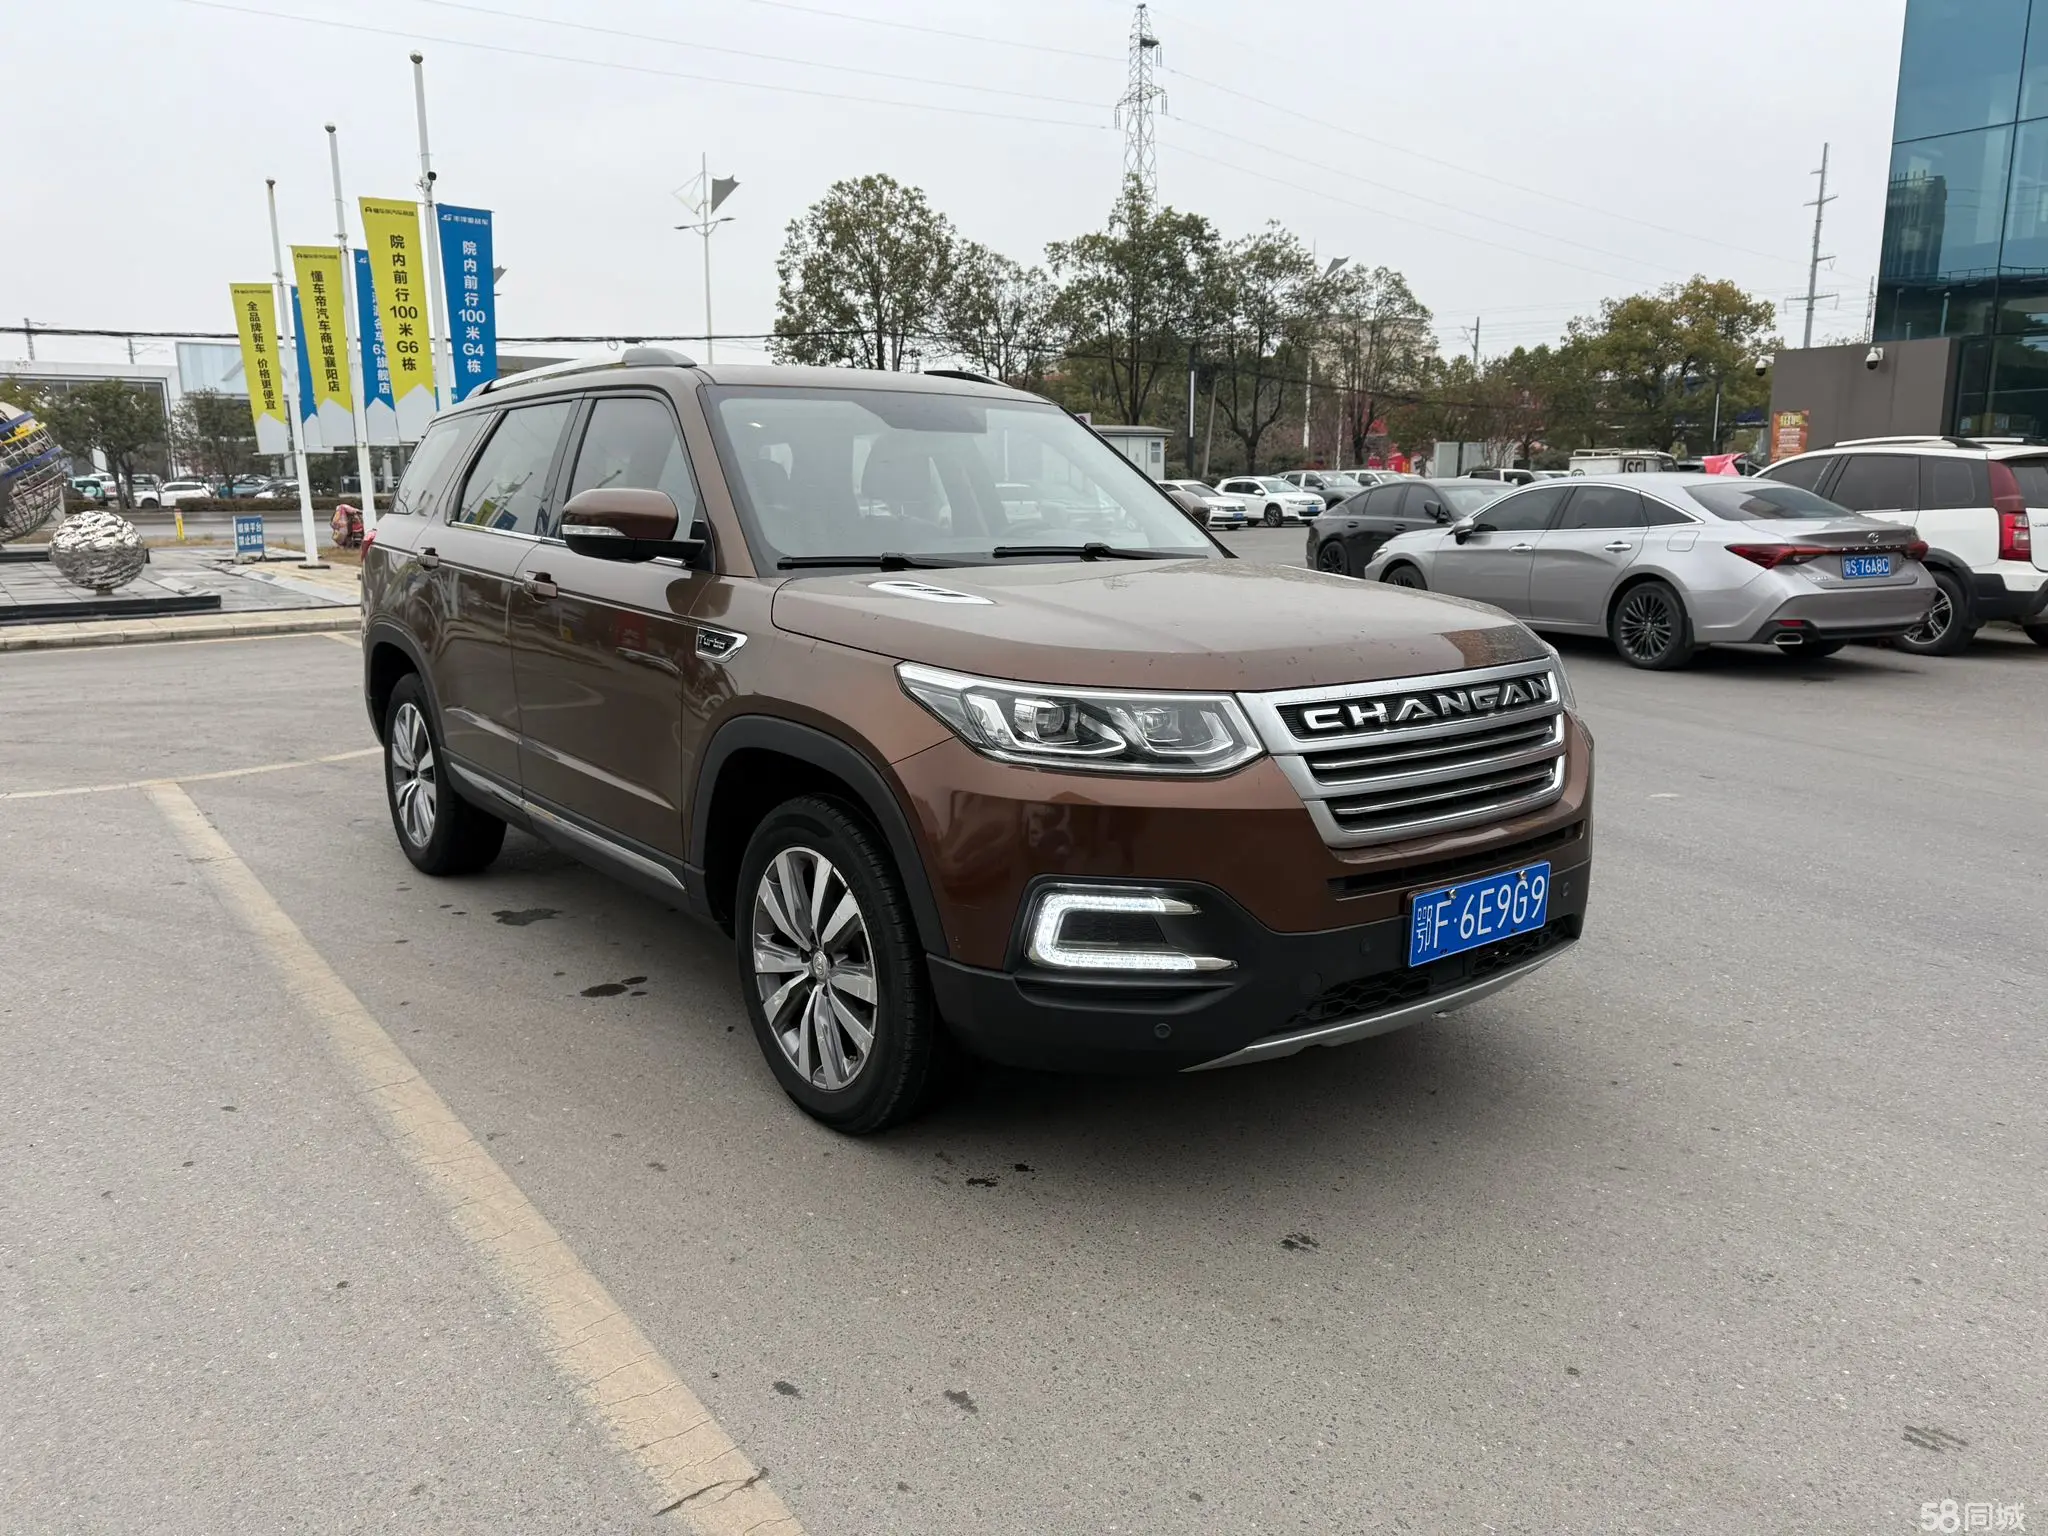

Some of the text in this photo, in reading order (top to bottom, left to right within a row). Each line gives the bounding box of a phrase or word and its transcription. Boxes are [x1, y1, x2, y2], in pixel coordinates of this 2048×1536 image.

[247, 301, 266, 354] 全品牌新车
[257, 358, 276, 410] 价格更便宜
[310, 270, 340, 393] 懂车帝汽车商城襄阳店
[389, 234, 419, 372] 院内前行100米G6栋
[458, 240, 487, 374] 院内前行100米G4栋
[1303, 677, 1550, 730] CHANGAN
